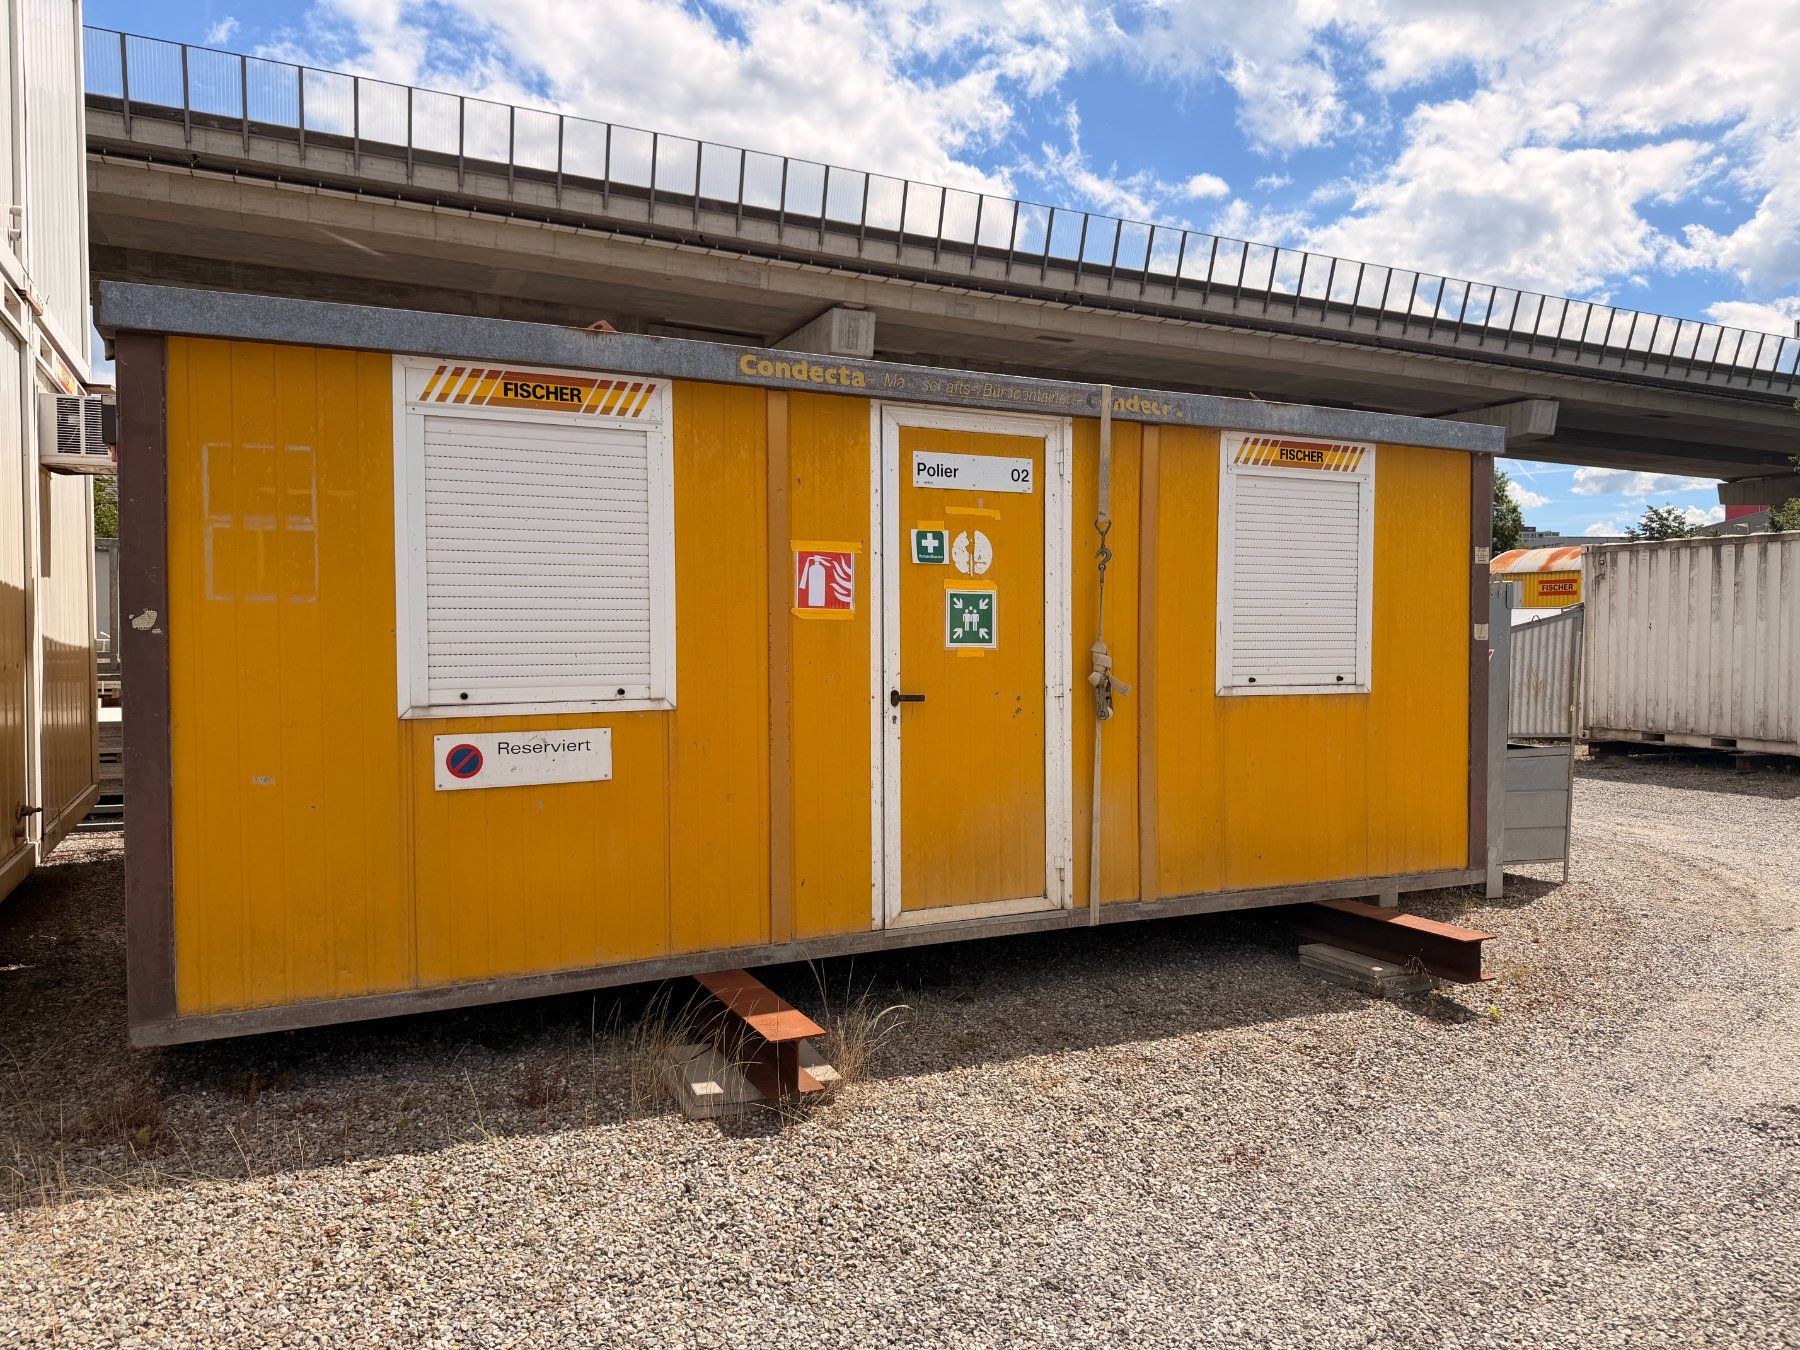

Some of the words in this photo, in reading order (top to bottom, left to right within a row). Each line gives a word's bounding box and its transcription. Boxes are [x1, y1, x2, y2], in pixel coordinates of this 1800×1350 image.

[739, 354, 866, 387] Condecta
[503, 381, 583, 403] FISCHER
[1280, 448, 1324, 462] FISCHER
[917, 462, 959, 478] Polier
[1010, 469, 1030, 482] 02
[1541, 583, 1574, 591] FISCHER
[497, 739, 592, 755] Reserviert
